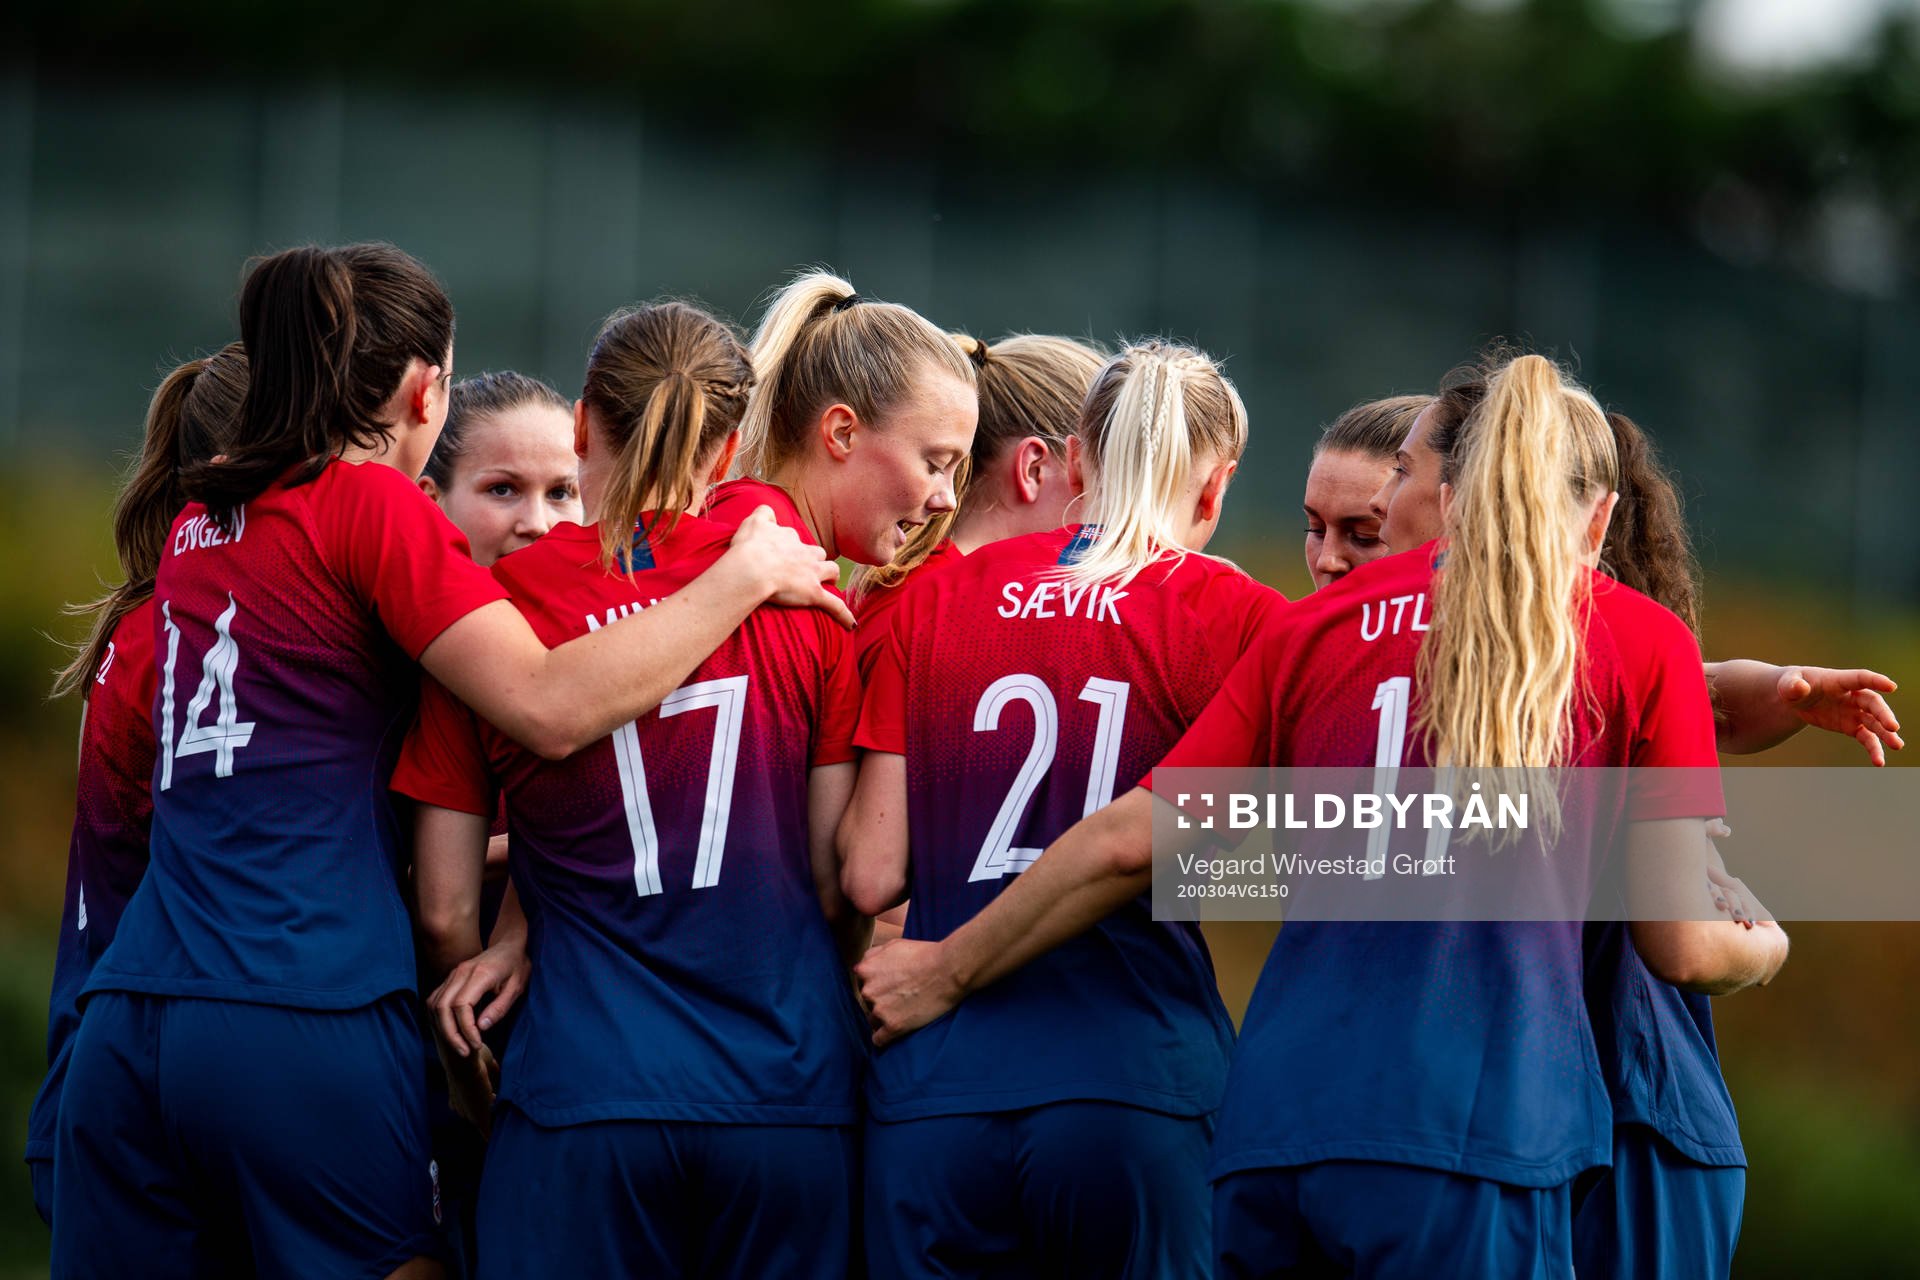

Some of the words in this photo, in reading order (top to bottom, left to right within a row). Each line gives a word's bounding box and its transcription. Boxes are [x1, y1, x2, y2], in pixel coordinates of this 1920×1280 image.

[160, 591, 256, 792] 14
[997, 581, 1130, 625] SÆVIK
[1360, 593, 1433, 642] UTL
[612, 674, 749, 897] 17
[967, 673, 1130, 883] 21
